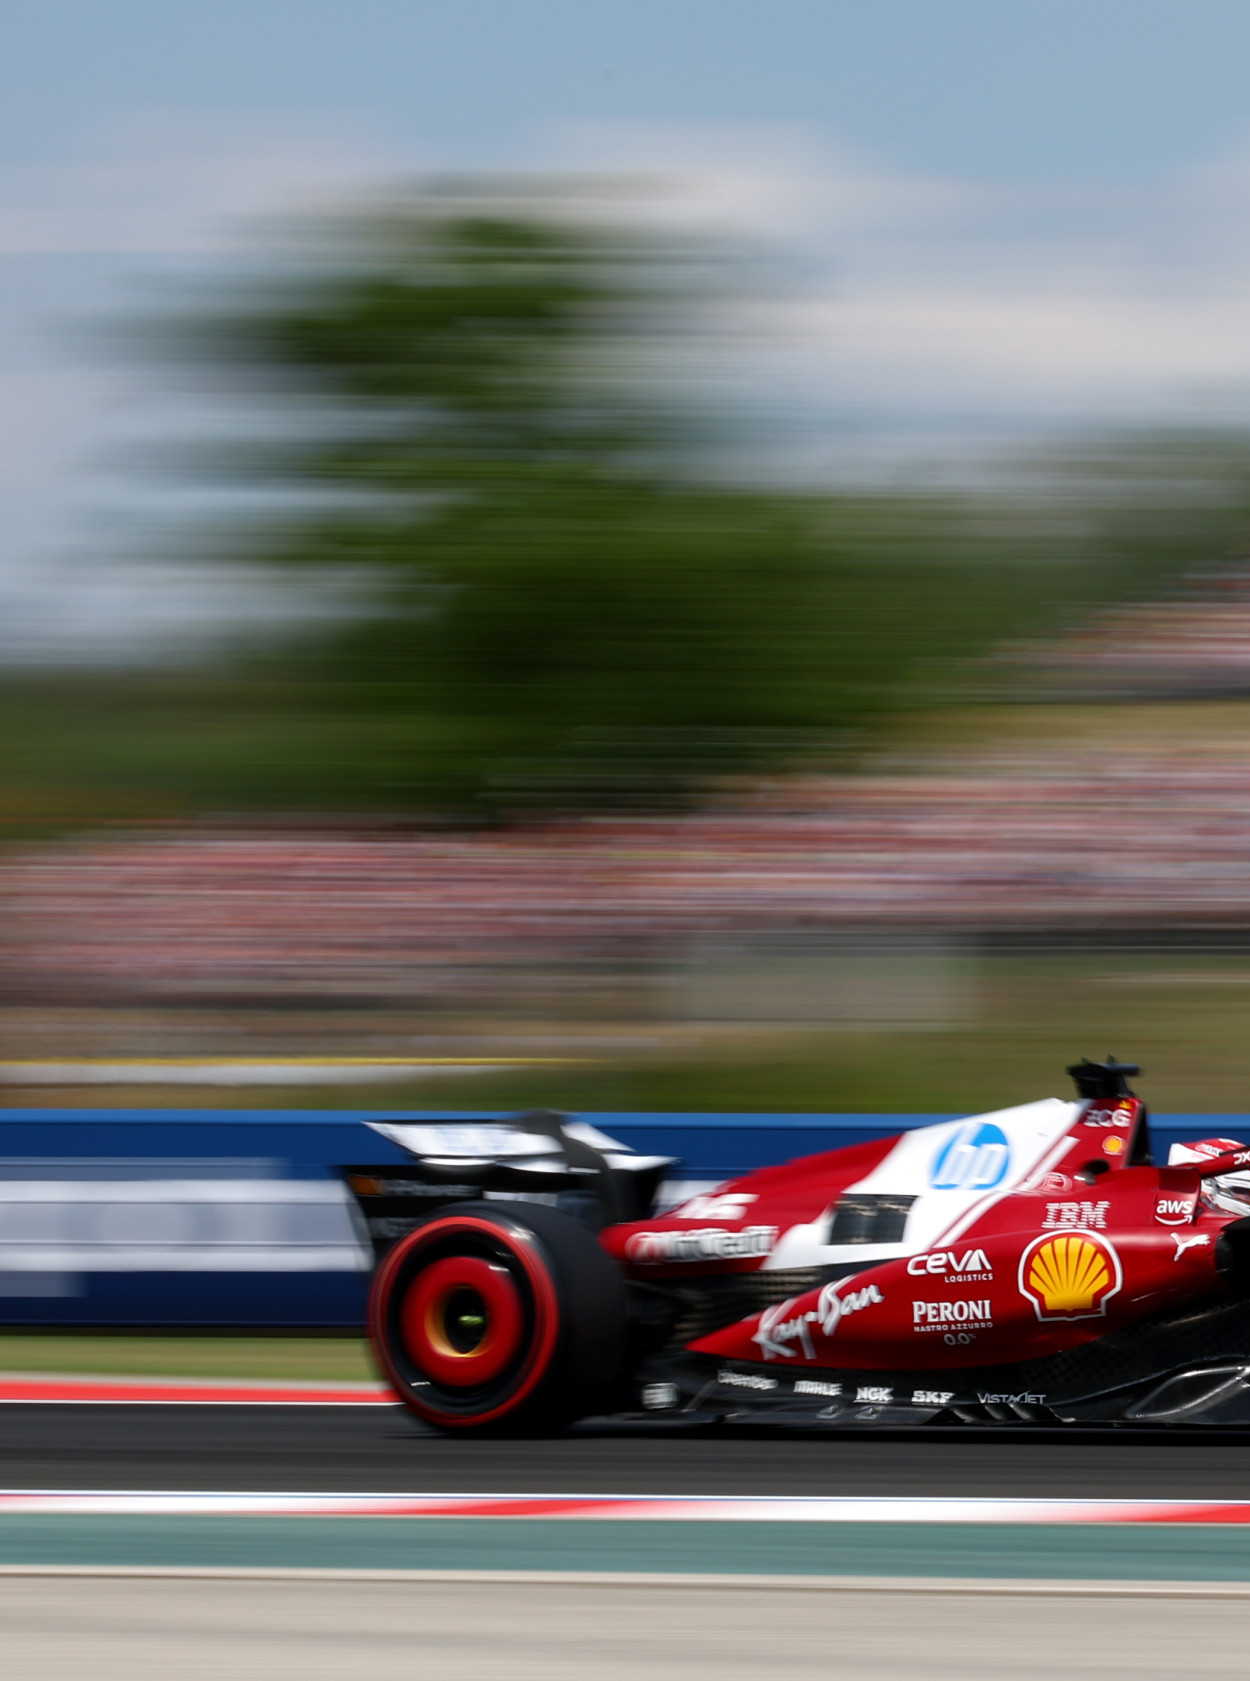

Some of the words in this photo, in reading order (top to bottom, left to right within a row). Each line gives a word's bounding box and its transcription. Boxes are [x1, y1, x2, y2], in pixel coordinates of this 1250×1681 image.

[1041, 1201, 1111, 1228] IBM
[1156, 1200, 1193, 1214] aws
[944, 1273, 994, 1283] LOGISTICS
[751, 1274, 885, 1360] Ray-Ban
[912, 1299, 992, 1323] PERONI
[913, 1324, 948, 1333] NASTRO
[950, 1321, 993, 1331] AZZURRO
[856, 1386, 893, 1402] NGK
[911, 1389, 955, 1404] SKF
